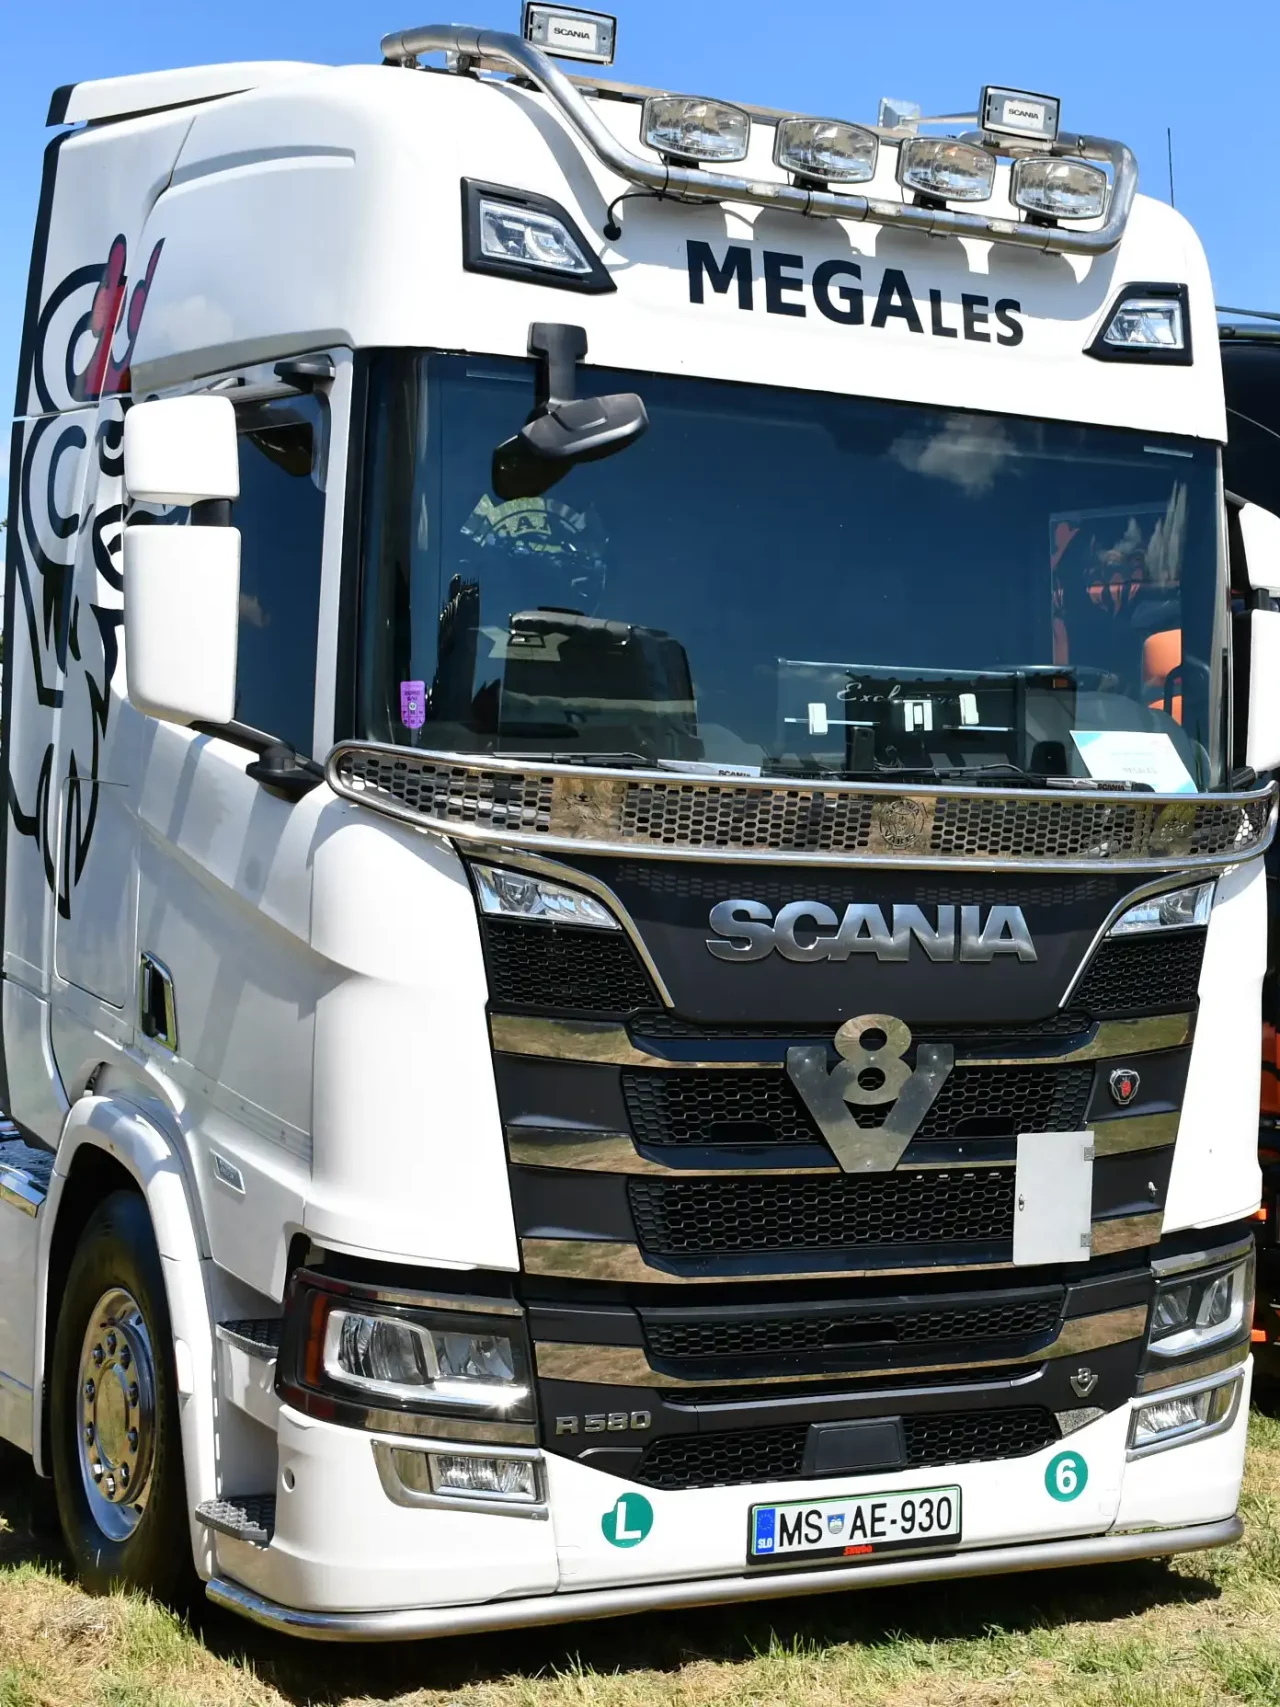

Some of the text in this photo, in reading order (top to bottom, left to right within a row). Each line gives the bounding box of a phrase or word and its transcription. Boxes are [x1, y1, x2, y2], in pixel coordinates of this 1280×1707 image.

[553, 27, 590, 39] SCANIA
[1008, 108, 1039, 119] SCANIA
[705, 899, 1038, 962] SCANIA
[555, 1411, 651, 1435] R 580
[1055, 1458, 1078, 1495] 6
[615, 1501, 642, 1540] L
[779, 1496, 953, 1548] MS AE-930
[758, 1538, 773, 1549] SLO
